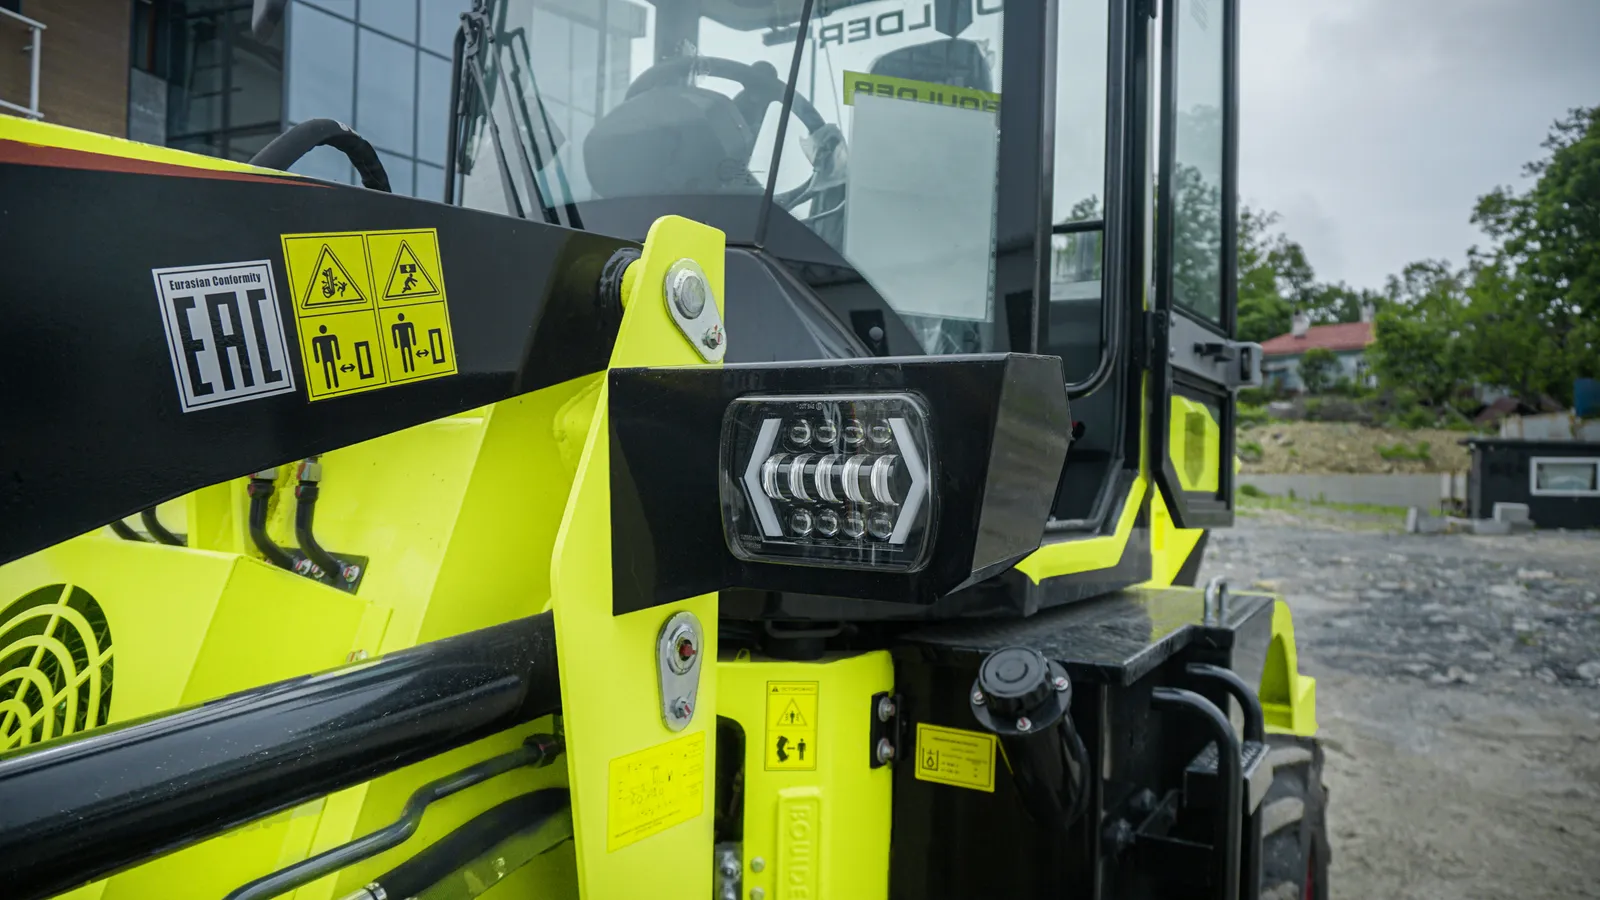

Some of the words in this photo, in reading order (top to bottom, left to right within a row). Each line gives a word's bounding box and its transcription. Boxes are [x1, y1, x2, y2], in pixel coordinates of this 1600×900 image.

[169, 277, 211, 290] Eurasian
[212, 272, 261, 286] Conformity
[172, 288, 284, 397] EAC
